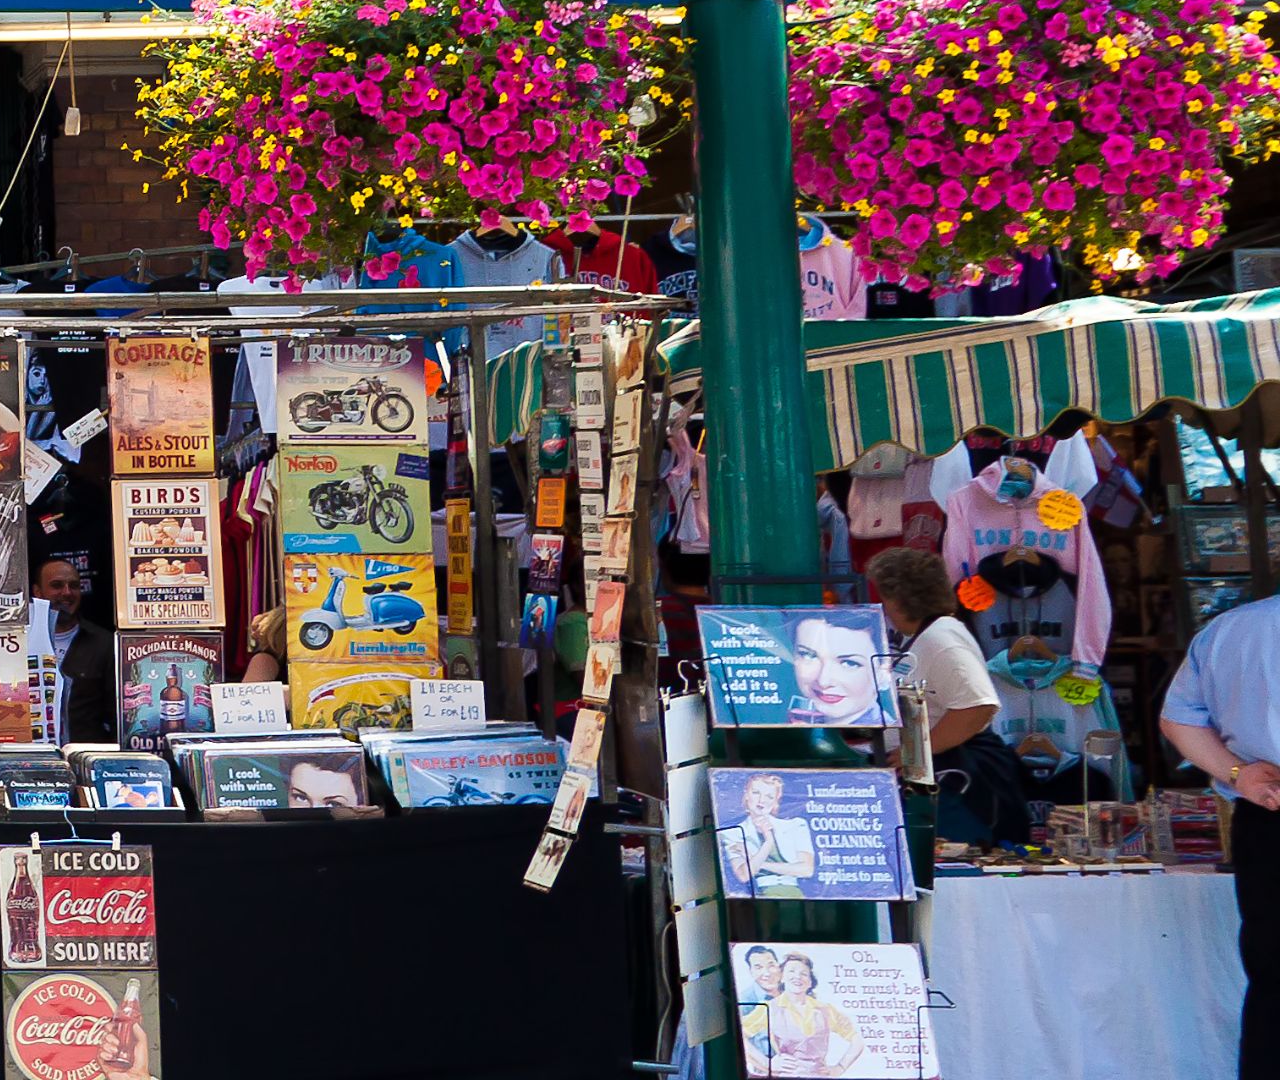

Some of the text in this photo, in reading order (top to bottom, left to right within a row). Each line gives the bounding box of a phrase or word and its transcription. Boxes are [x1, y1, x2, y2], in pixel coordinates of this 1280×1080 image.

[113, 342, 207, 367] COURAGE
[288, 342, 412, 368] TRIUMPH
[117, 434, 210, 451] ALES & STOUT
[131, 454, 196, 469] IN BOTTLE
[284, 455, 338, 473] Norton
[131, 486, 201, 505] BIRD'S
[133, 603, 210, 619] HOME SPECIALITIES
[729, 623, 760, 636] cook
[710, 637, 780, 649] with wine.
[127, 640, 218, 662] ROCHDALE & MANOR
[710, 653, 782, 665] Sometimes
[736, 668, 768, 678] even
[239, 685, 271, 696] EACH
[439, 682, 473, 694] EACH
[749, 680, 761, 692] it
[763, 681, 779, 692] to
[439, 694, 455, 704] OR
[746, 692, 783, 705] food.
[423, 704, 434, 718] 2
[440, 707, 459, 718] FOR
[130, 736, 154, 750] OLD
[228, 768, 261, 780] I cook
[219, 780, 277, 792] with wine.
[807, 784, 877, 798] I understand
[219, 796, 278, 807] Sometimes
[806, 800, 883, 817] the concept of
[810, 817, 883, 832] COOKING &
[815, 835, 886, 849] CLEANING.
[53, 851, 140, 871] ICE COLD
[819, 852, 887, 866] Just not as it
[818, 869, 856, 884] applies
[857, 870, 871, 882] to
[46, 888, 149, 925] Coca-Cola
[53, 941, 150, 961] SOLD HERE
[851, 950, 880, 965] Oh,
[834, 965, 905, 980] I'm sorry.
[33, 983, 97, 1006] ICE COLD
[828, 981, 921, 995] You must be
[842, 996, 917, 1012] confusing
[857, 1012, 919, 1024] me with
[860, 1026, 929, 1039] the maid
[867, 1043, 889, 1054] we
[31, 1058, 101, 1080] SOLD HERE
